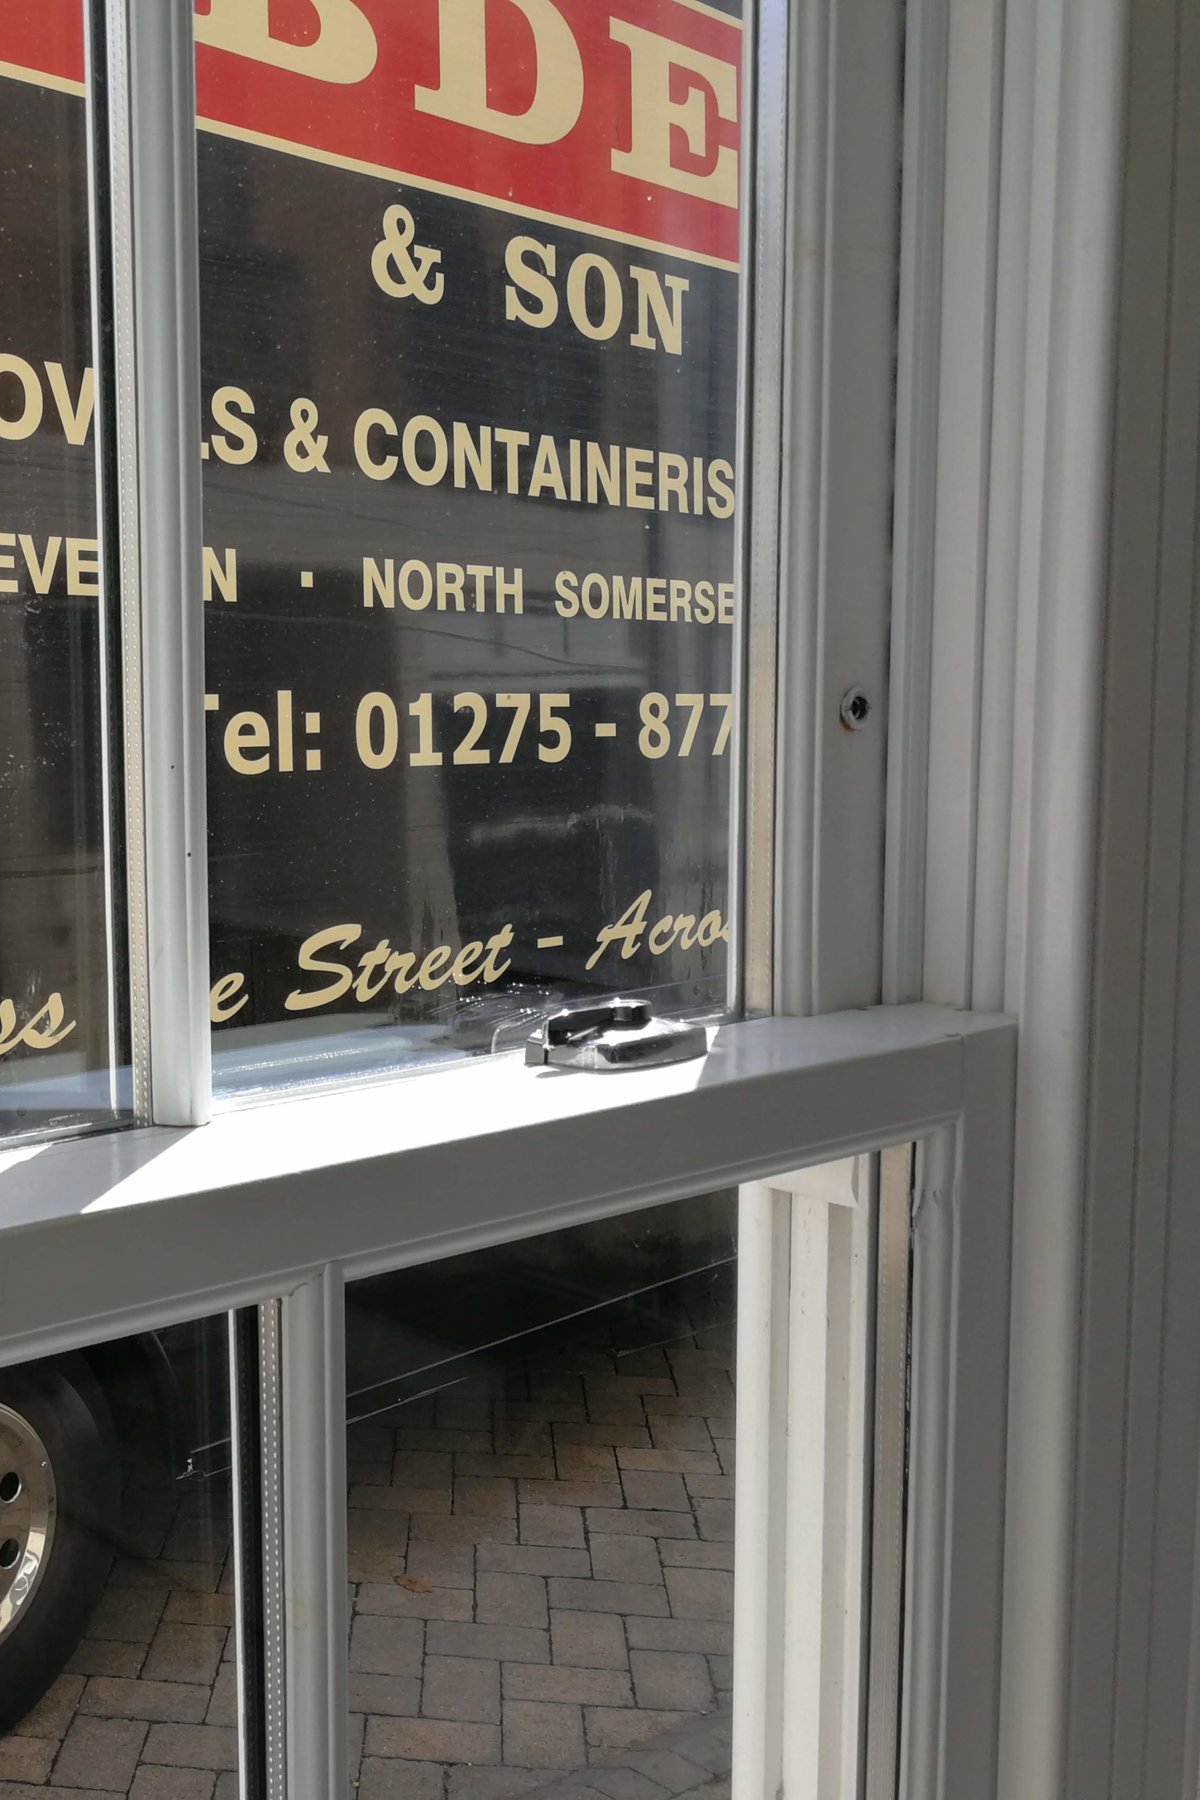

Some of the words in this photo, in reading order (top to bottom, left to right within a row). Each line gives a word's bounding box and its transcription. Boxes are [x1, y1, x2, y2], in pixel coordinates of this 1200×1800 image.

[371, 204, 445, 305] &
[505, 236, 690, 355] SON
[283, 398, 331, 473] &
[362, 557, 524, 614] NORTH
[355, 691, 572, 770] 01275
[285, 923, 514, 1011] Street
